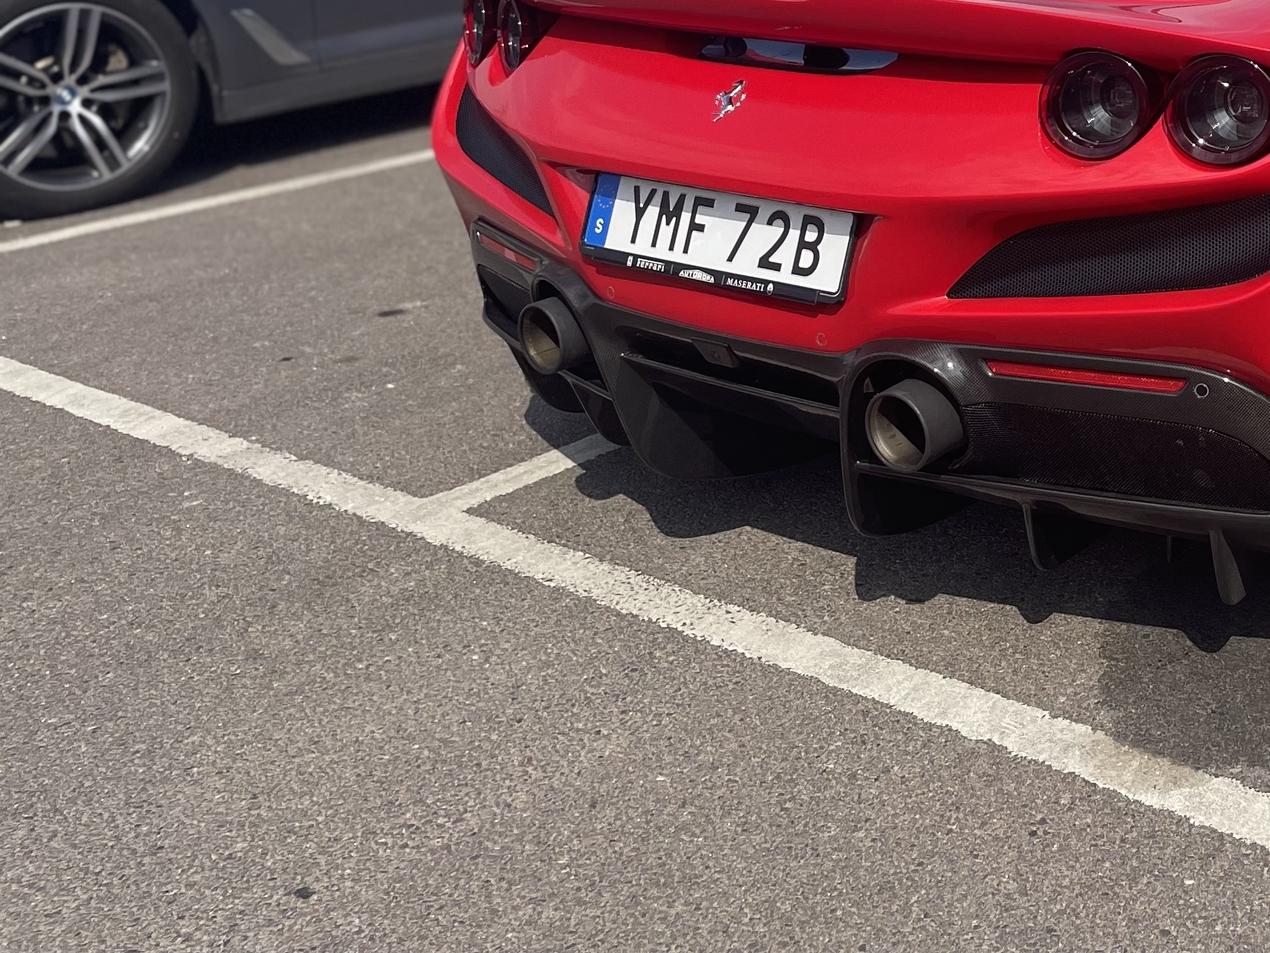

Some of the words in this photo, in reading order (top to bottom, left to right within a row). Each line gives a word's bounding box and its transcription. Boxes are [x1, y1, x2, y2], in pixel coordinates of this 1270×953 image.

[594, 218, 605, 234] S
[630, 184, 716, 255] YMF
[726, 202, 825, 277] 72B
[636, 258, 665, 273] Ferrari
[726, 277, 765, 292] MASERATI
